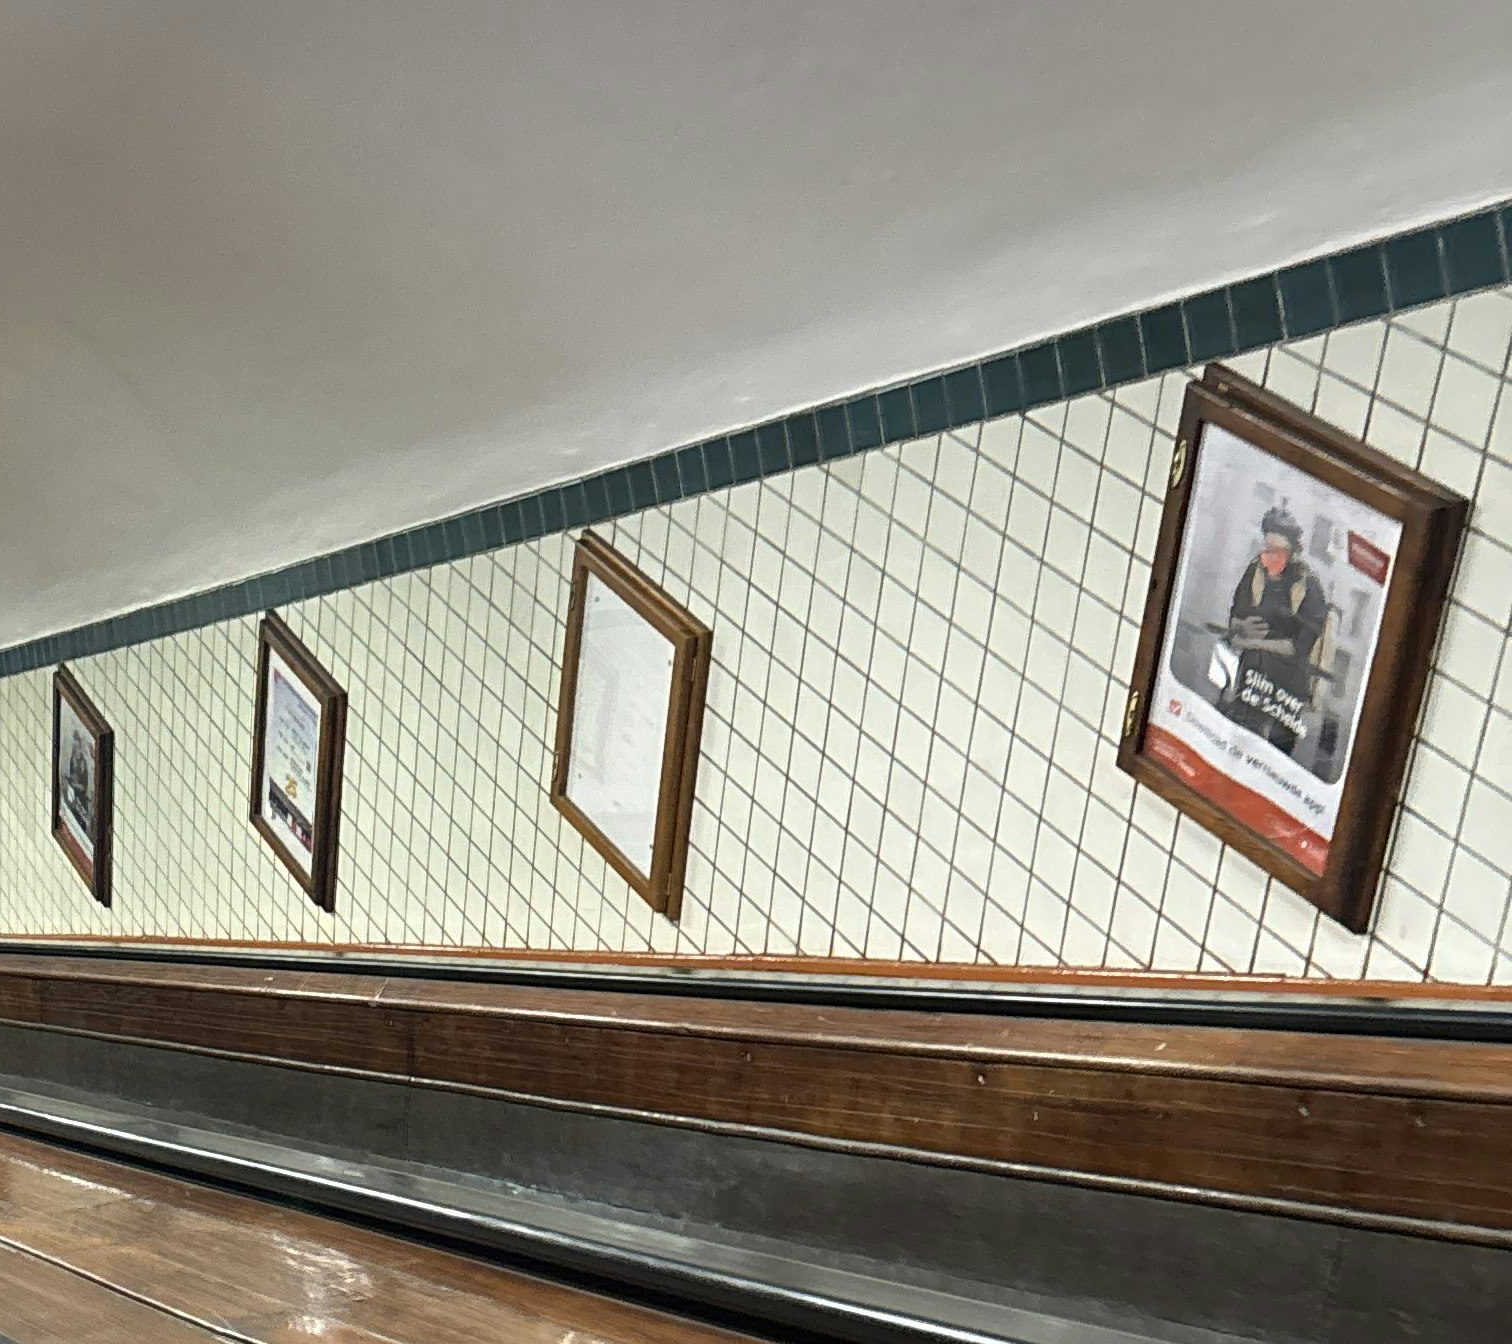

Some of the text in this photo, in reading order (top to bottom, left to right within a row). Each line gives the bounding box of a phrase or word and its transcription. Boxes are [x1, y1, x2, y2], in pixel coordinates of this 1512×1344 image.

[1241, 687, 1260, 706] de
[1245, 669, 1304, 716] Slim over
